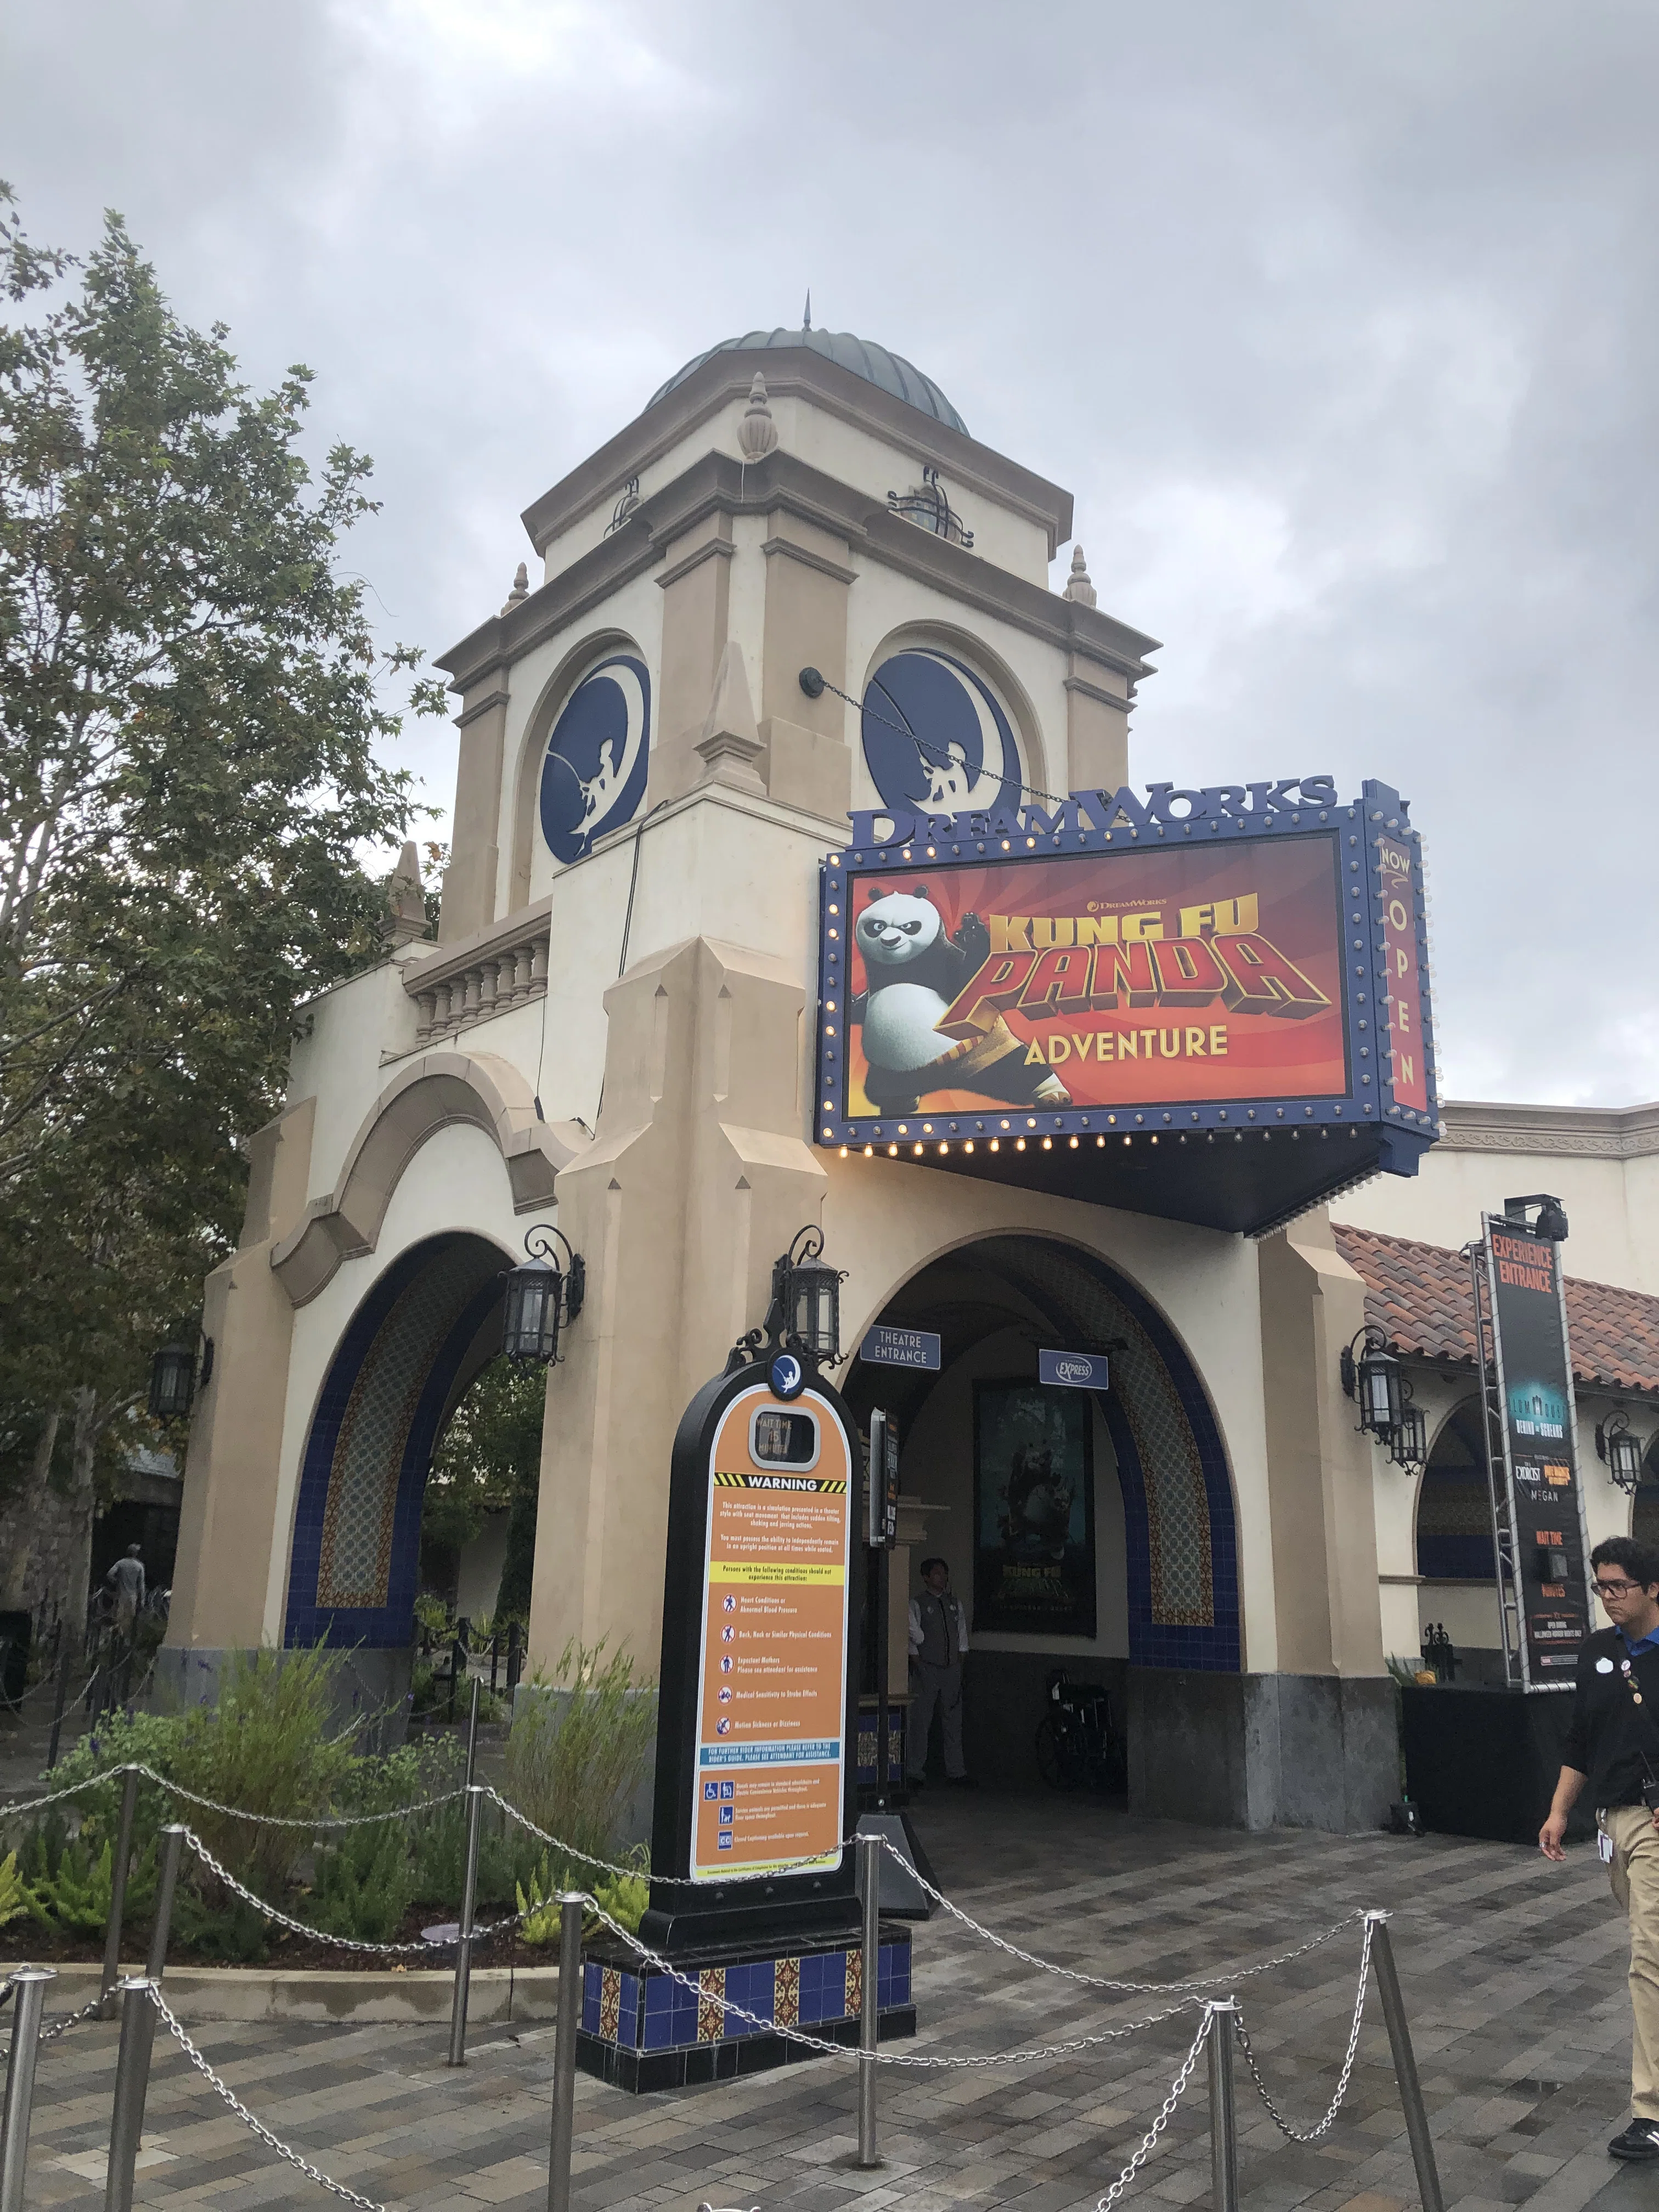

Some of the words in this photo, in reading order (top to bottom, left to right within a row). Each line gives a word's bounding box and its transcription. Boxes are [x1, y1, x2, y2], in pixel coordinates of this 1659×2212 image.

[845, 775, 1338, 849] DREAMWORKS
[1381, 847, 1410, 875] NOW
[988, 912, 1166, 953] KUNG
[1177, 891, 1259, 938] FU
[933, 933, 1333, 1039] PANDA
[1024, 1025, 1228, 1065] ADVENTURE
[1492, 1233, 1553, 1269] EXPERIENCE
[1499, 1260, 1552, 1294] ENTRANCE
[880, 1330, 921, 1348] THEATRE
[874, 1345, 927, 1364] ENTRANCE
[1059, 1362, 1089, 1380] EXPRESS
[757, 1418, 774, 1427] WAIT
[775, 1419, 792, 1430] TIME
[748, 1476, 817, 1491] WARNING
[763, 1566, 784, 1575] following
[719, 1747, 739, 1755] FURTHER
[740, 1746, 753, 1754] RIDER
[754, 1745, 785, 1753] INFORMATION
